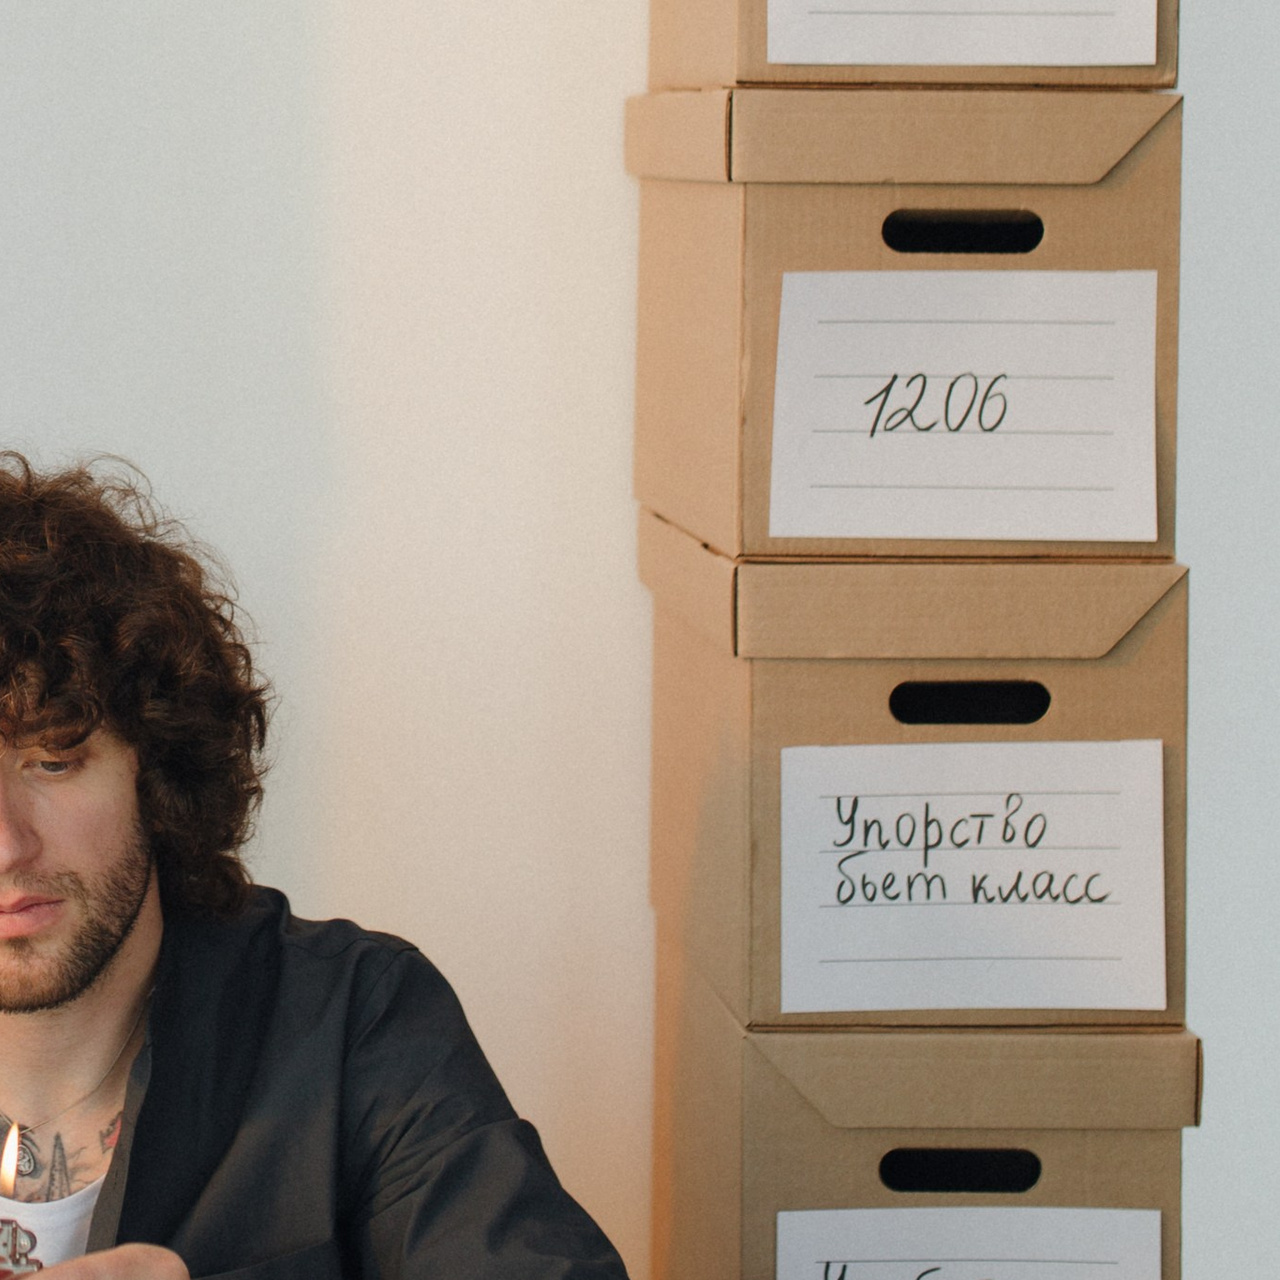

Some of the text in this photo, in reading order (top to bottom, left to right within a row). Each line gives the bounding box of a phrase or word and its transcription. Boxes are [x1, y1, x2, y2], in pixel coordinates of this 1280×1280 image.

[864, 372, 1008, 439] 1206
[833, 792, 1048, 868] Упорство
[836, 850, 1111, 907] бьет класс
